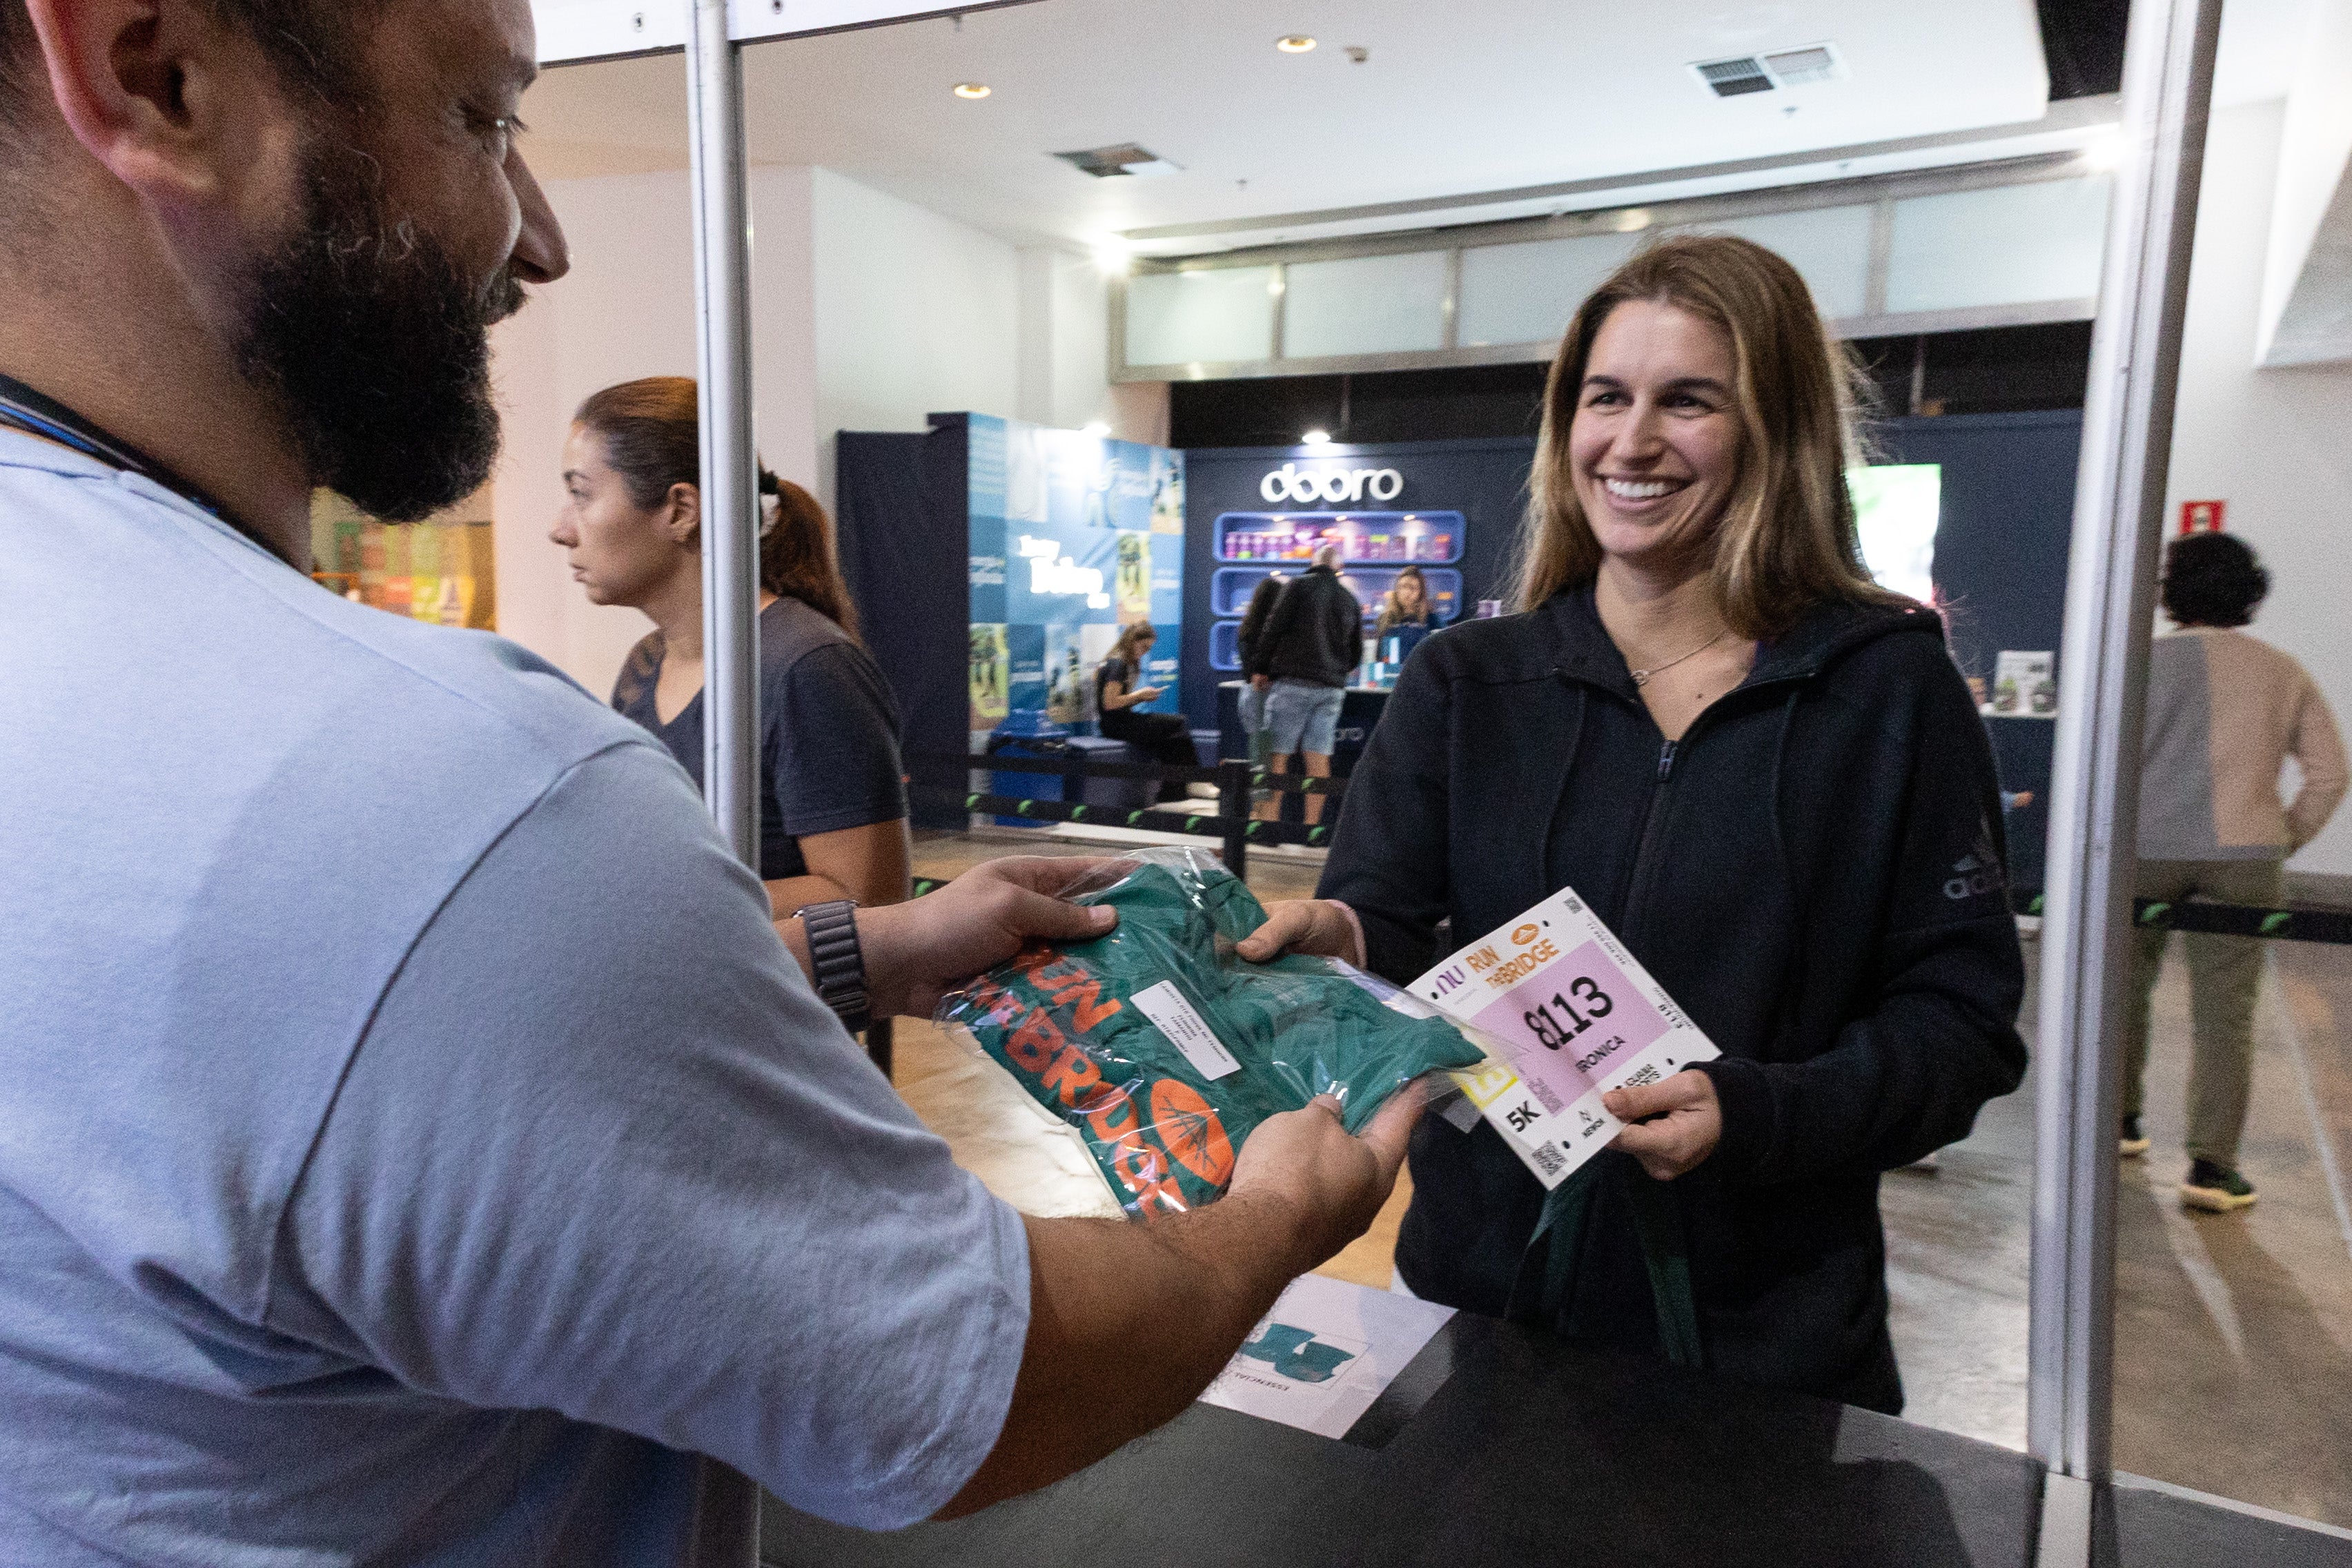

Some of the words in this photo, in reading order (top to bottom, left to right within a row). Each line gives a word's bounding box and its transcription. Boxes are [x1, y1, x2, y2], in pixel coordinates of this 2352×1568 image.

[1260, 463, 1404, 502] dobro
[1465, 945, 1501, 974] RUN
[1498, 938, 1560, 985] BRIDGE
[1523, 977, 1614, 1051] 8113
[1505, 1100, 1541, 1133] 5K
